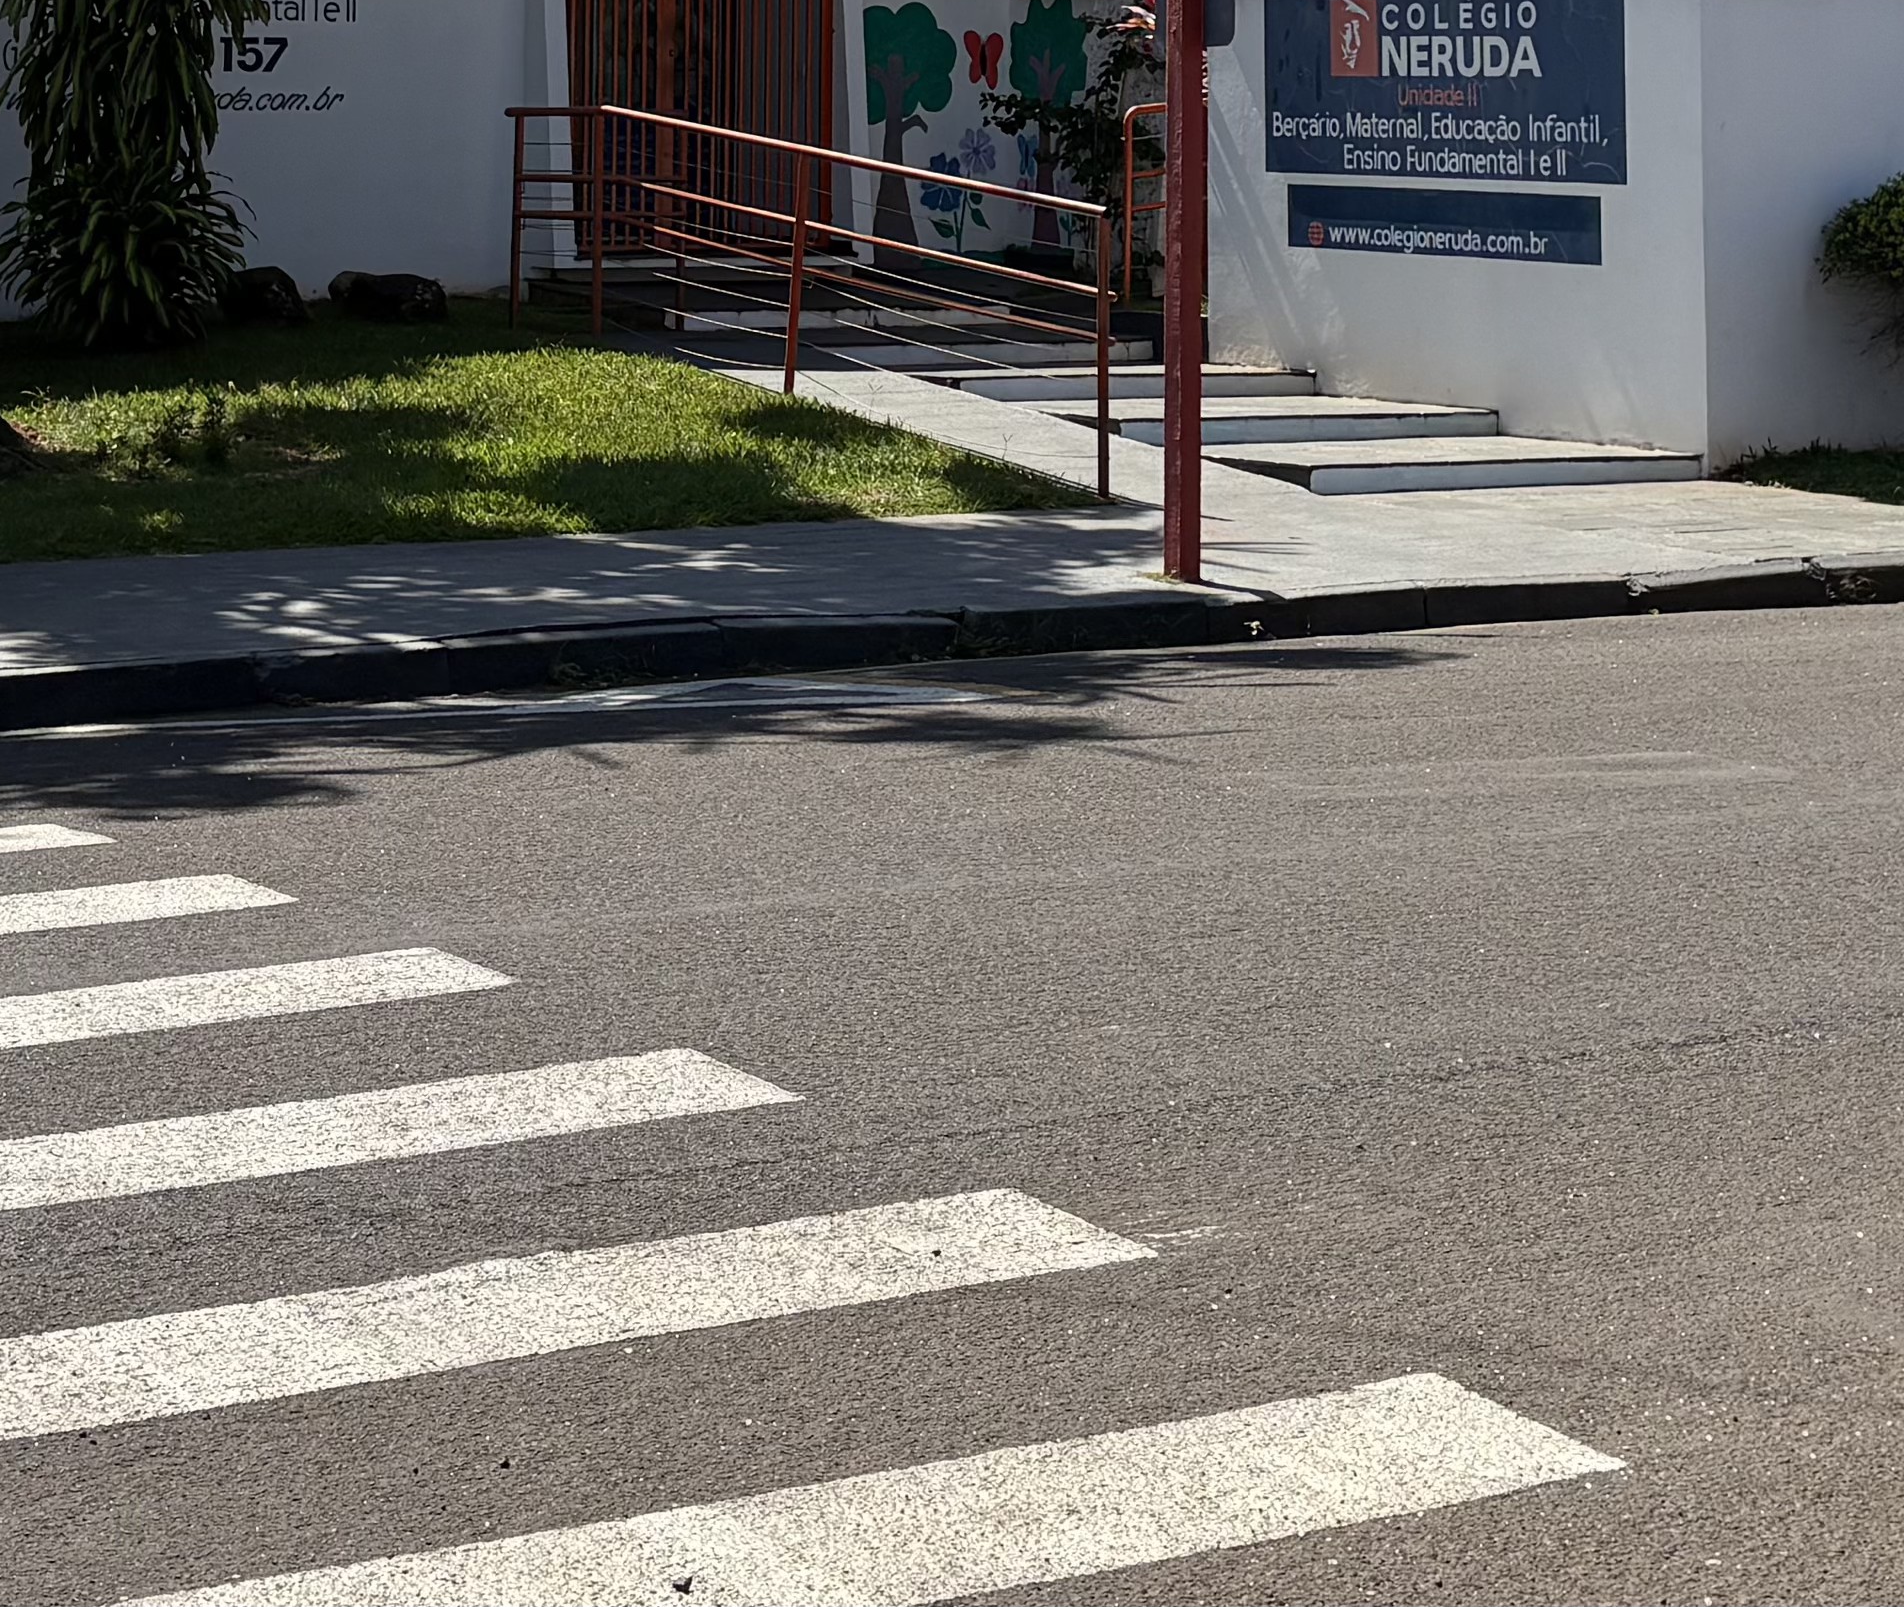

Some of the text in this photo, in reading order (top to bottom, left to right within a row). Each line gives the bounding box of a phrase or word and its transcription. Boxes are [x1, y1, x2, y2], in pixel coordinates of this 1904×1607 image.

[1381, 35, 1543, 78] NERUDA
[1397, 83, 1464, 106] Unidade
[1272, 111, 1608, 146] Berçário, Maternal, Educação Infantil,
[1343, 143, 1401, 171] Ensino
[1406, 145, 1523, 175] Fundamental
[1539, 155, 1552, 176] e
[1329, 225, 1548, 255] www.colegioneruda.com.br
